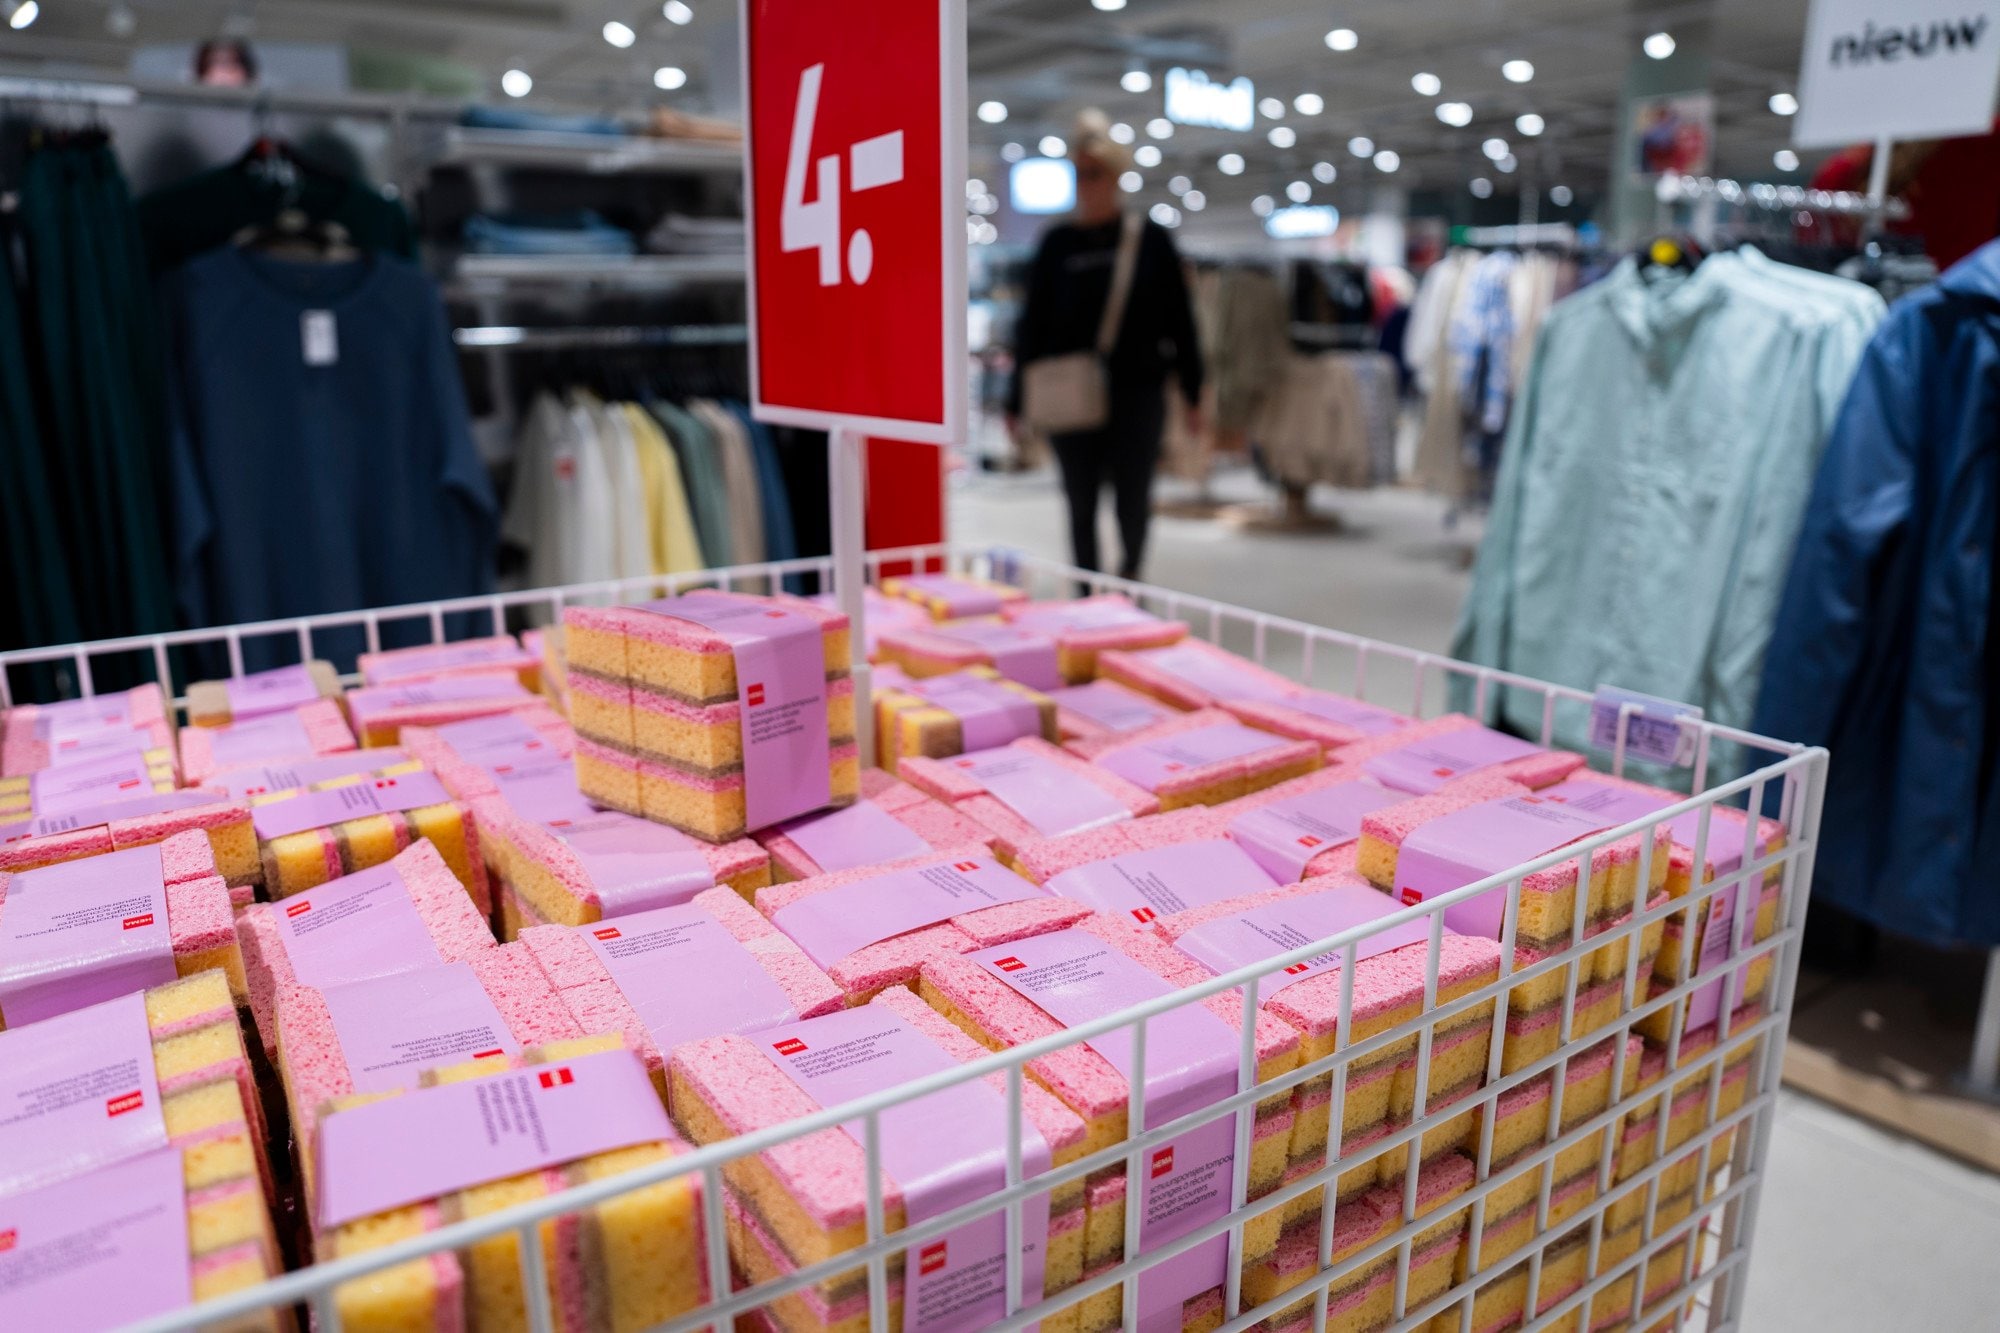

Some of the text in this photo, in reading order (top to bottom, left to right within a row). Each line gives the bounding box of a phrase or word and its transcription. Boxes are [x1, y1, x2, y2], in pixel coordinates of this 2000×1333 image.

[1829, 12, 1987, 68] nieuw
[124, 916, 153, 927] HEMA
[662, 920, 705, 933] tompouce
[596, 930, 620, 939] HEMA
[608, 936, 676, 955] sponge scourers
[1000, 960, 1021, 969] HEMA
[778, 1042, 803, 1053] HEMA
[789, 1027, 901, 1063] schuursponsjes tompouce
[799, 1047, 874, 1074] sponge scourers
